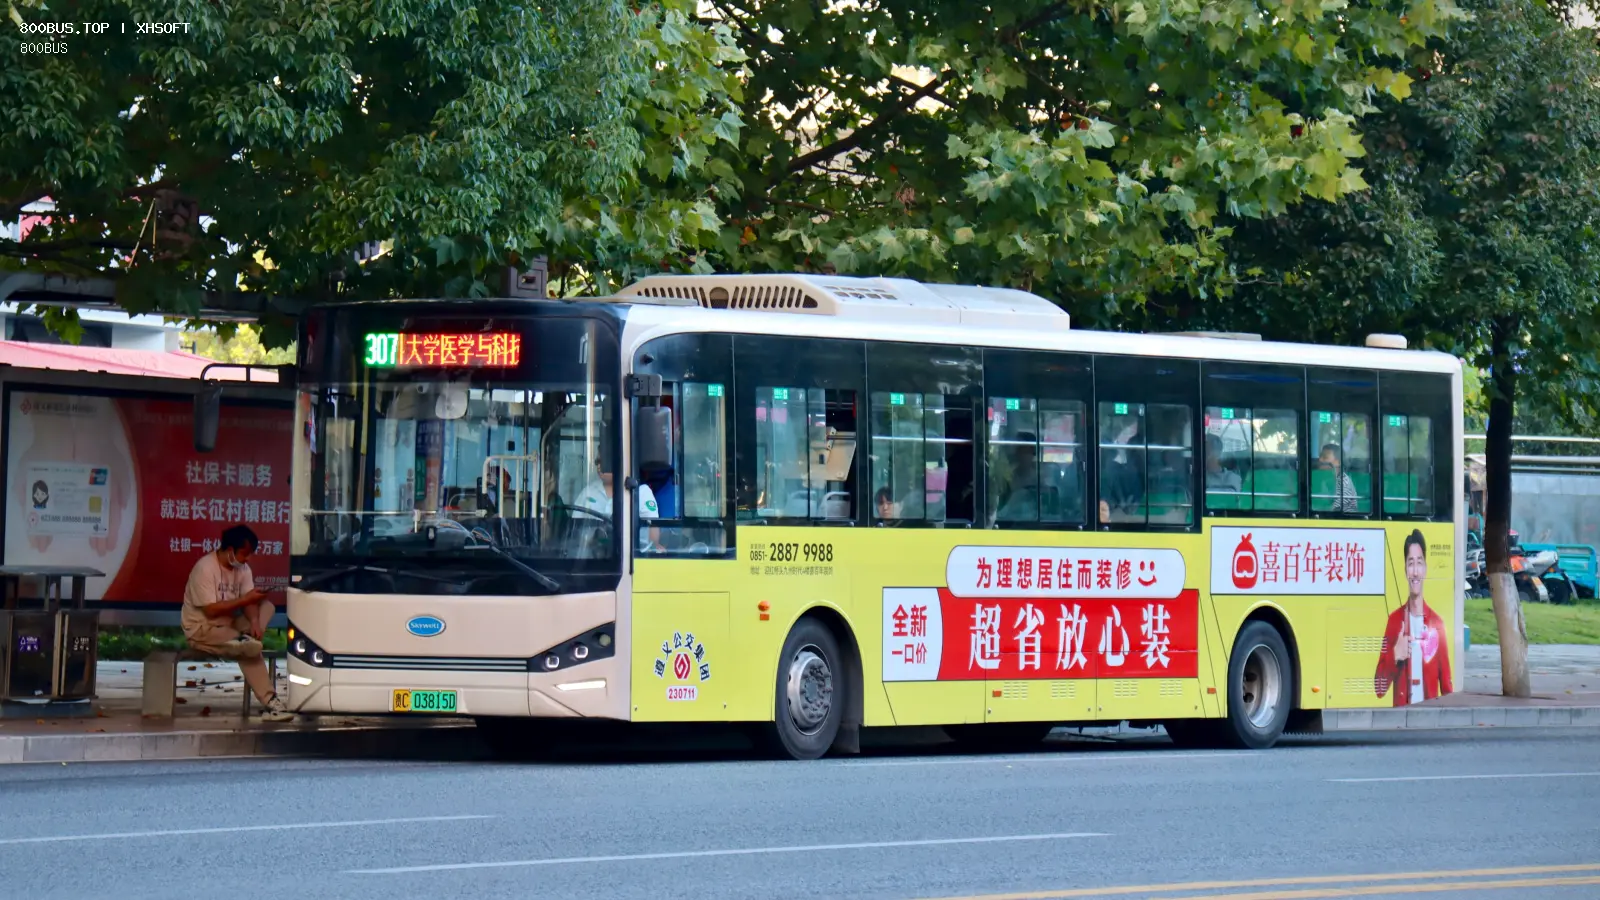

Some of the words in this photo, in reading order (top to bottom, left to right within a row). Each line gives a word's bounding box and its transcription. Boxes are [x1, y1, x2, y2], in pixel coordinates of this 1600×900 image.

[365, 332, 399, 365] 307
[185, 460, 273, 488] 社保卡服务
[160, 496, 291, 524] 就选长征村镇银行
[769, 542, 799, 562] 2887
[803, 543, 833, 562] 9988
[1260, 541, 1365, 584] 喜百年装饰
[976, 557, 1132, 589] 为理想居住而装修
[891, 604, 928, 638] 全新
[968, 603, 1171, 671] 超省放心装
[654, 631, 711, 682] 遵义公交集团
[891, 642, 928, 665] 一口价
[668, 688, 696, 700] 230711
